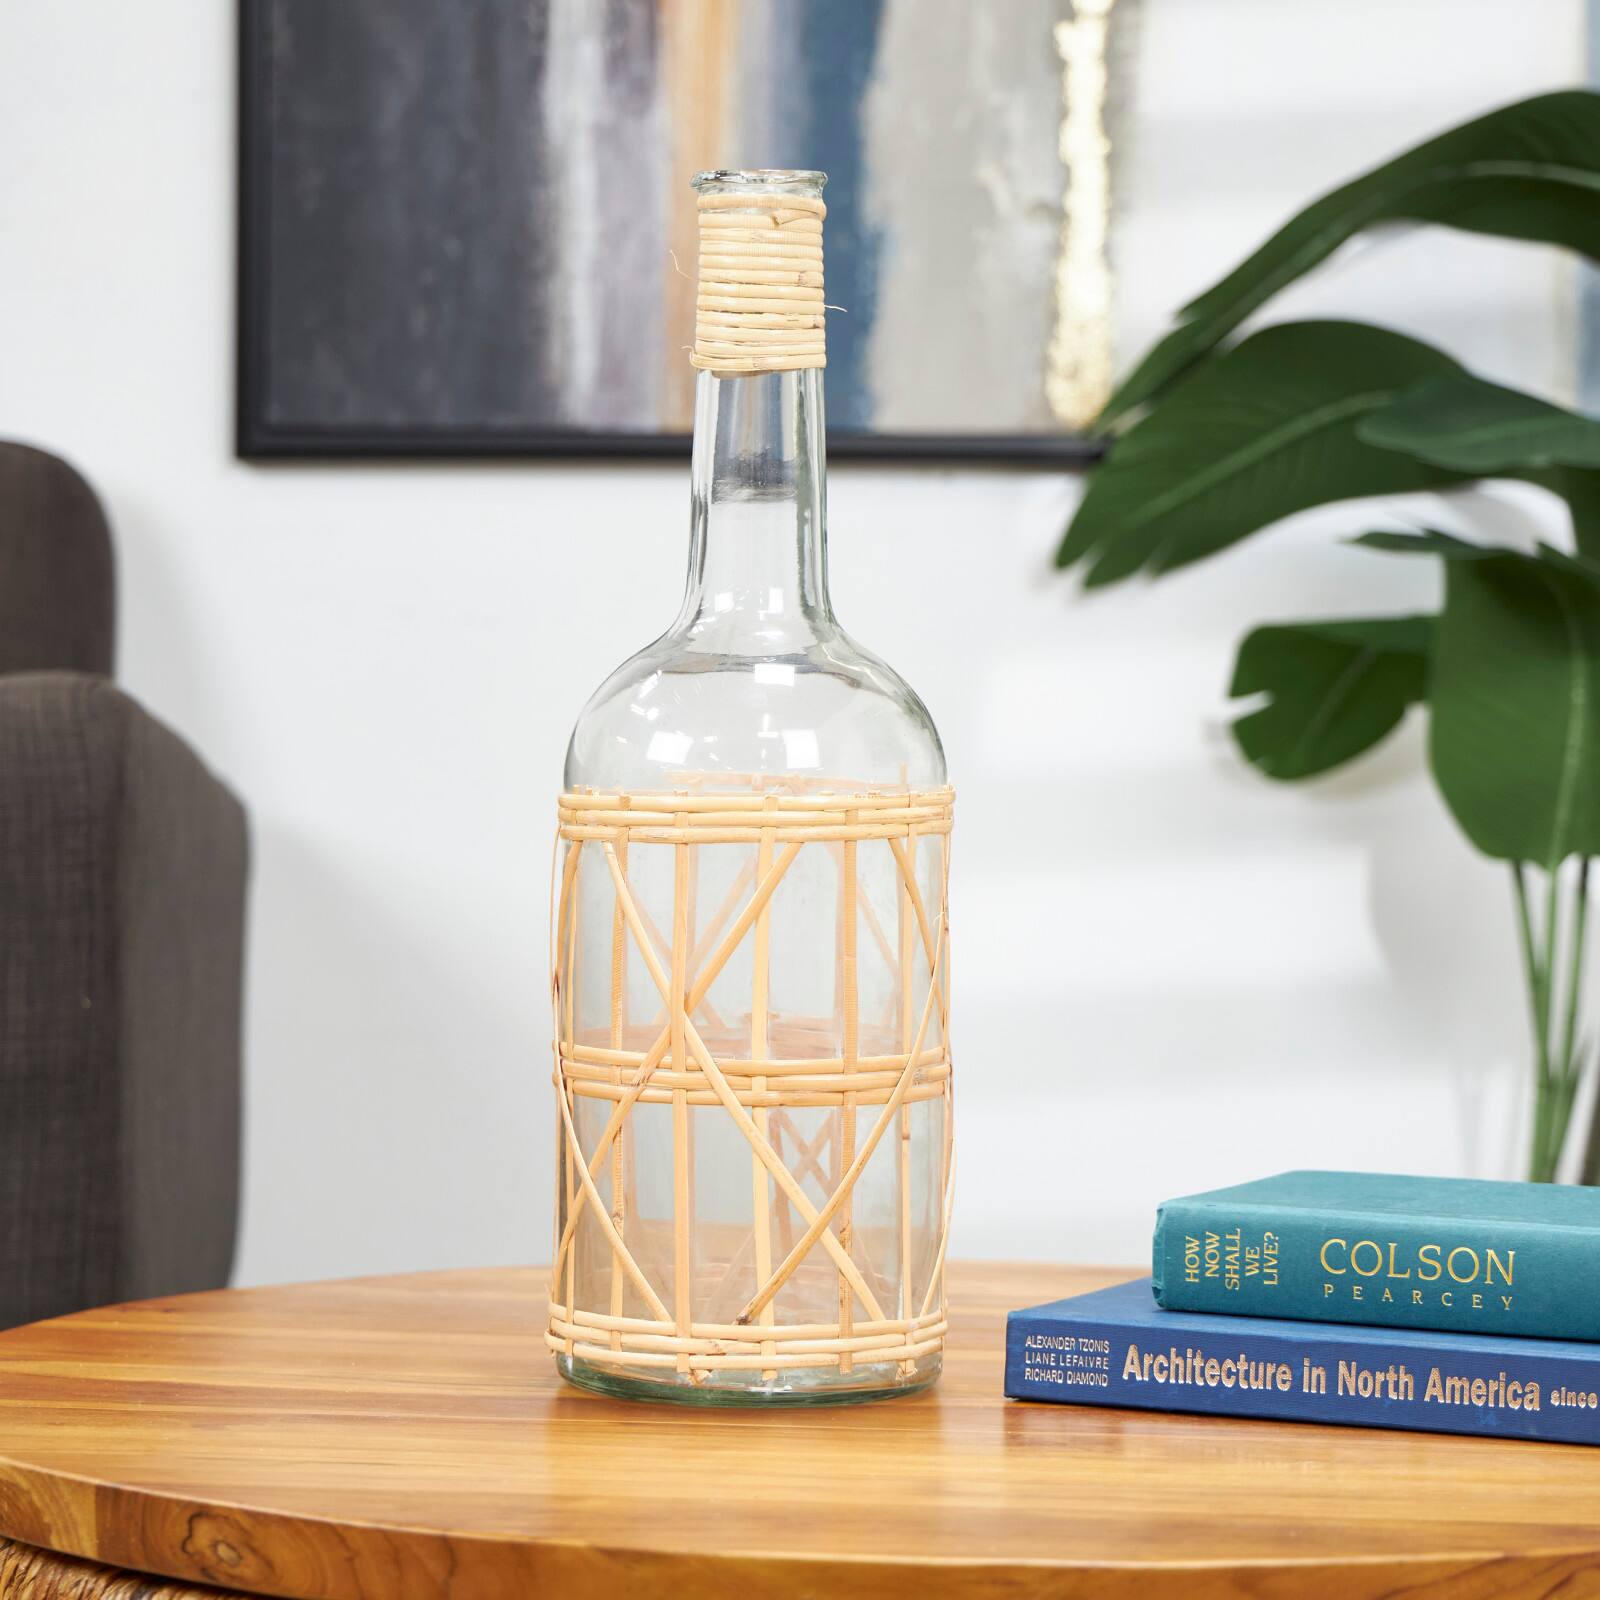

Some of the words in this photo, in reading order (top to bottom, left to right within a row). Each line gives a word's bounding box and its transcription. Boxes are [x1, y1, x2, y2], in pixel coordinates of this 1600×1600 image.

[1184, 1235, 1200, 1283] HOW
[1204, 1231, 1220, 1277] NOW
[1225, 1227, 1241, 1290] SHALL
[1245, 1246, 1261, 1277] WE
[1263, 1231, 1279, 1285] LIVE?
[1319, 1238, 1516, 1287] COLSON
[1323, 1283, 1513, 1311] PEARCEY
[1025, 1335, 1076, 1351] ALEXANDER
[1078, 1338, 1110, 1354] TZONIS
[1025, 1351, 1056, 1366] LIANE
[1059, 1354, 1109, 1370] LEFAIVRE
[1024, 1367, 1064, 1384] RICHARD
[1066, 1371, 1108, 1387] DIAMOND
[1122, 1344, 1293, 1392] Architecture
[1303, 1357, 1326, 1394] in
[1338, 1360, 1414, 1401] North
[1424, 1366, 1541, 1411] America
[1550, 1387, 1598, 1409] since
